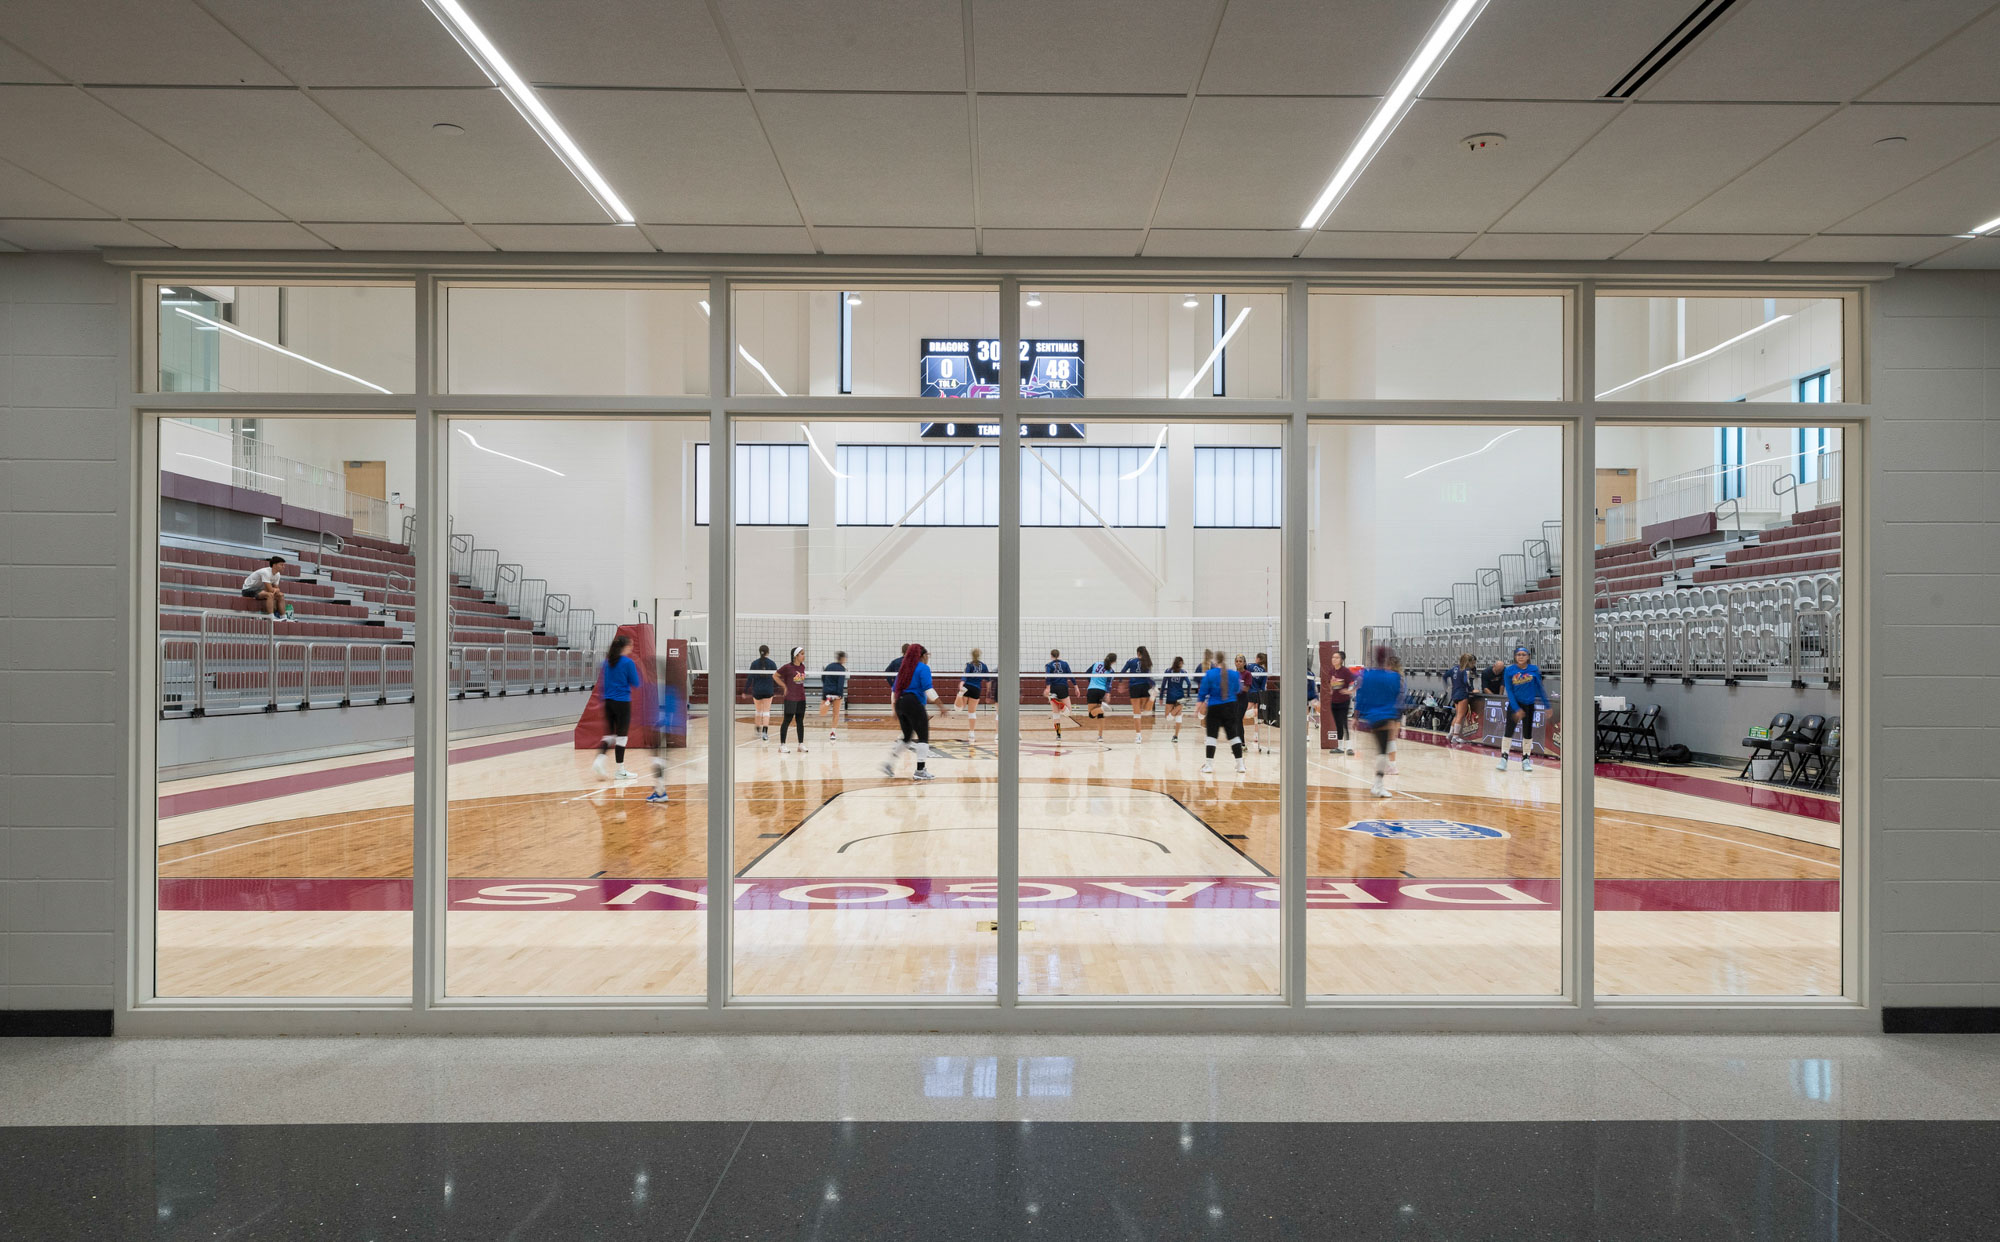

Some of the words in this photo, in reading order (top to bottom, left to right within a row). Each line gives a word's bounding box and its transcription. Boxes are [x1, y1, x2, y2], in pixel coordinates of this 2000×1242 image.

[929, 342, 969, 352] DRAGONS
[1036, 342, 1079, 352] SENTINALS
[941, 359, 953, 378] 0
[1046, 360, 1070, 379] 48
[947, 423, 955, 436] 0
[1049, 424, 1057, 436] 0
